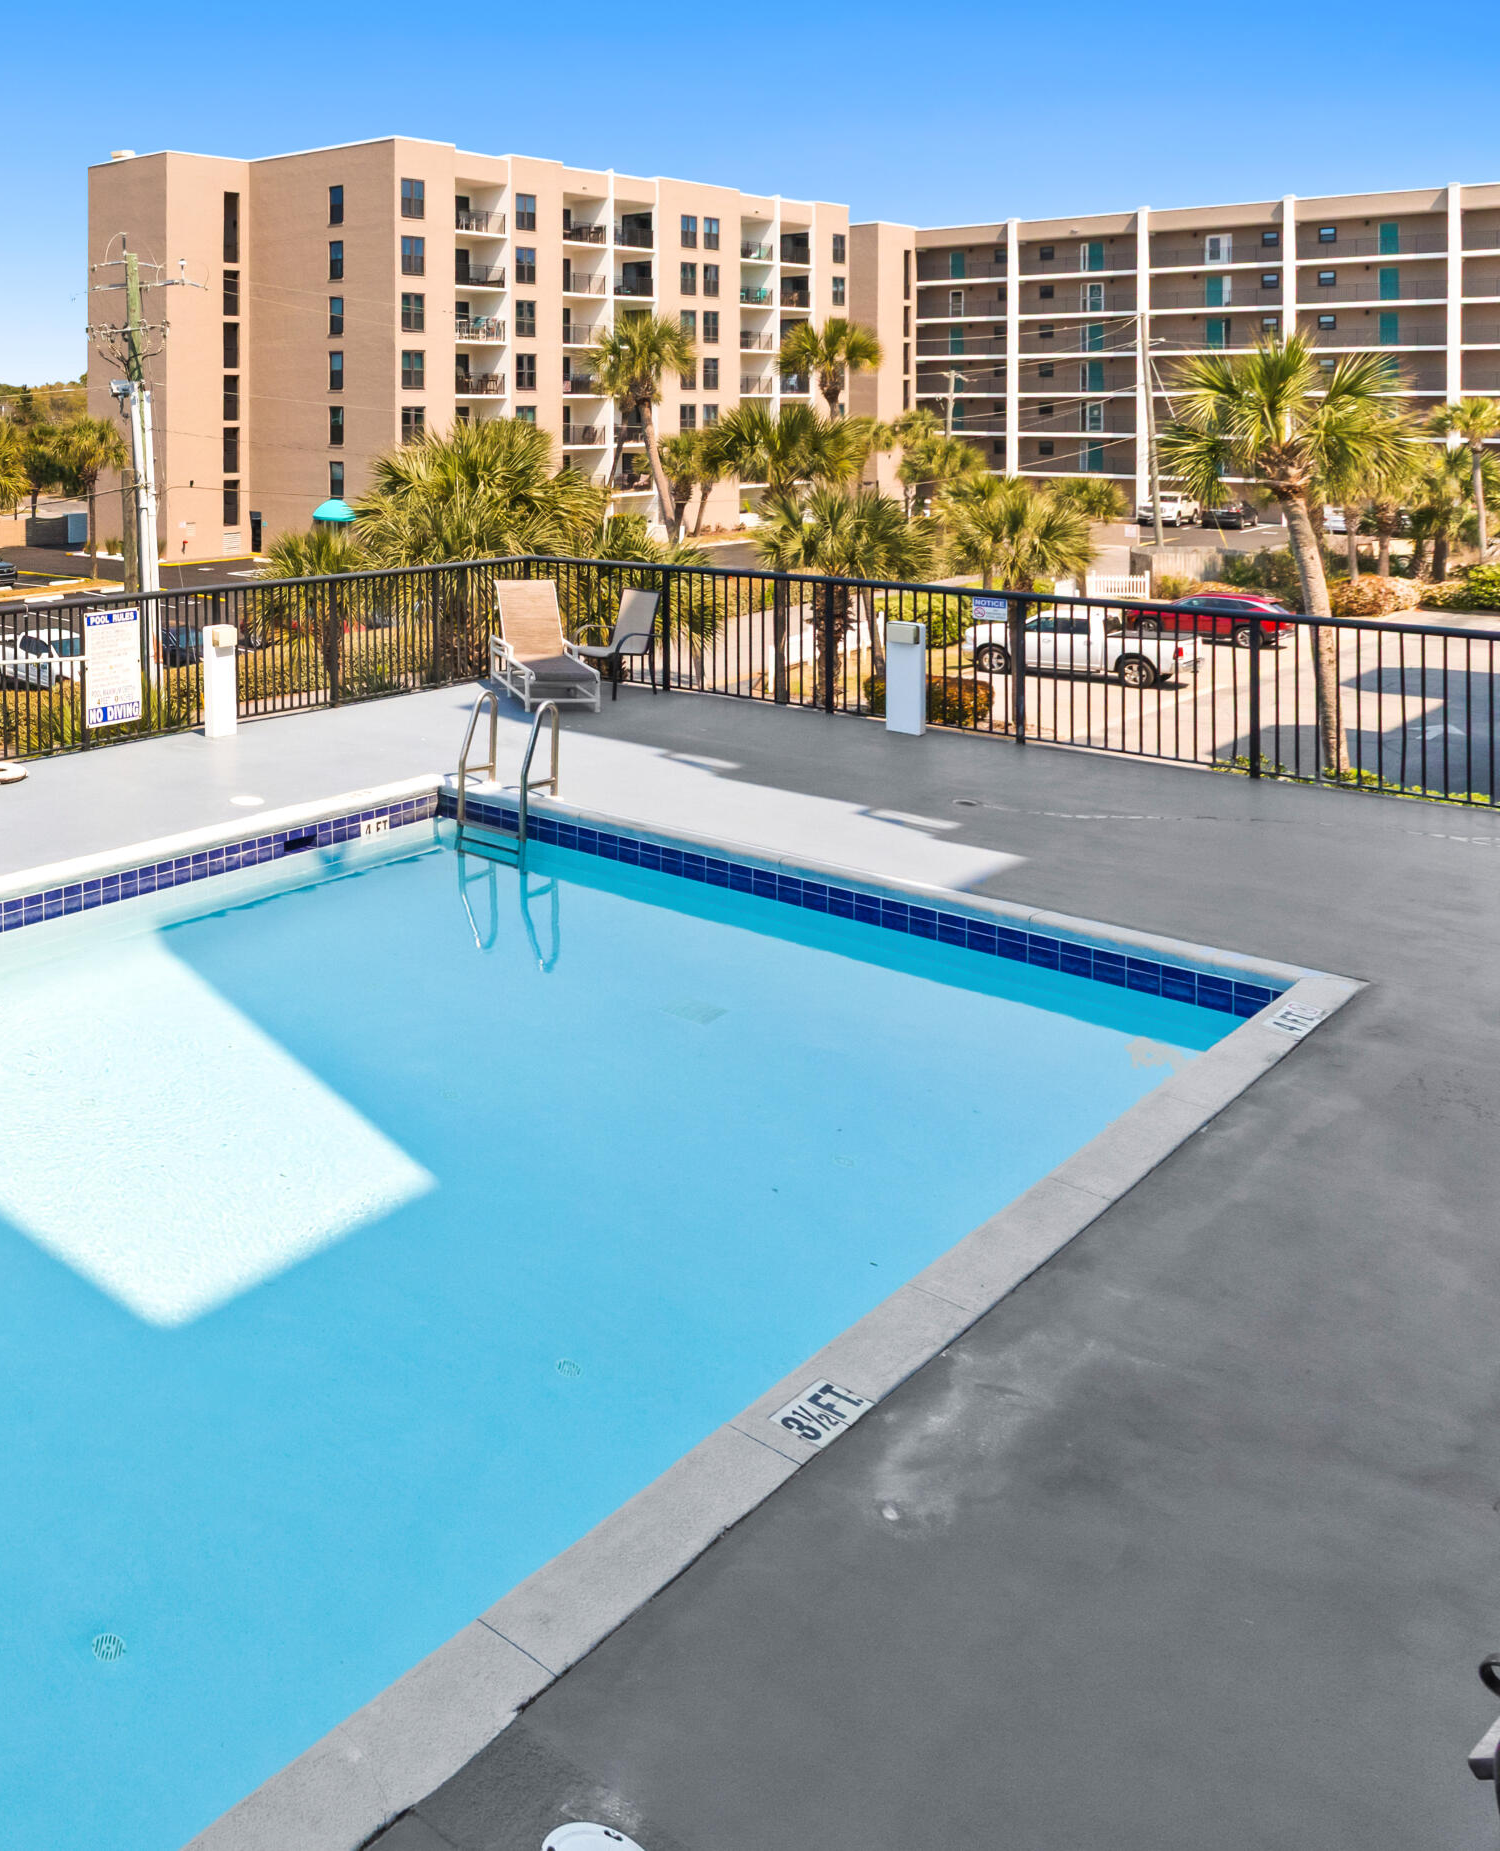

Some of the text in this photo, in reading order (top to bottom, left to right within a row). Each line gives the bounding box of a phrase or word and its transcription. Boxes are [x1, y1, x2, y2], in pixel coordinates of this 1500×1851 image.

[974, 599, 1005, 608] NOTICE
[90, 611, 134, 625] POOL RULES
[89, 701, 139, 724] NO DIVING
[376, 820, 388, 832] FT
